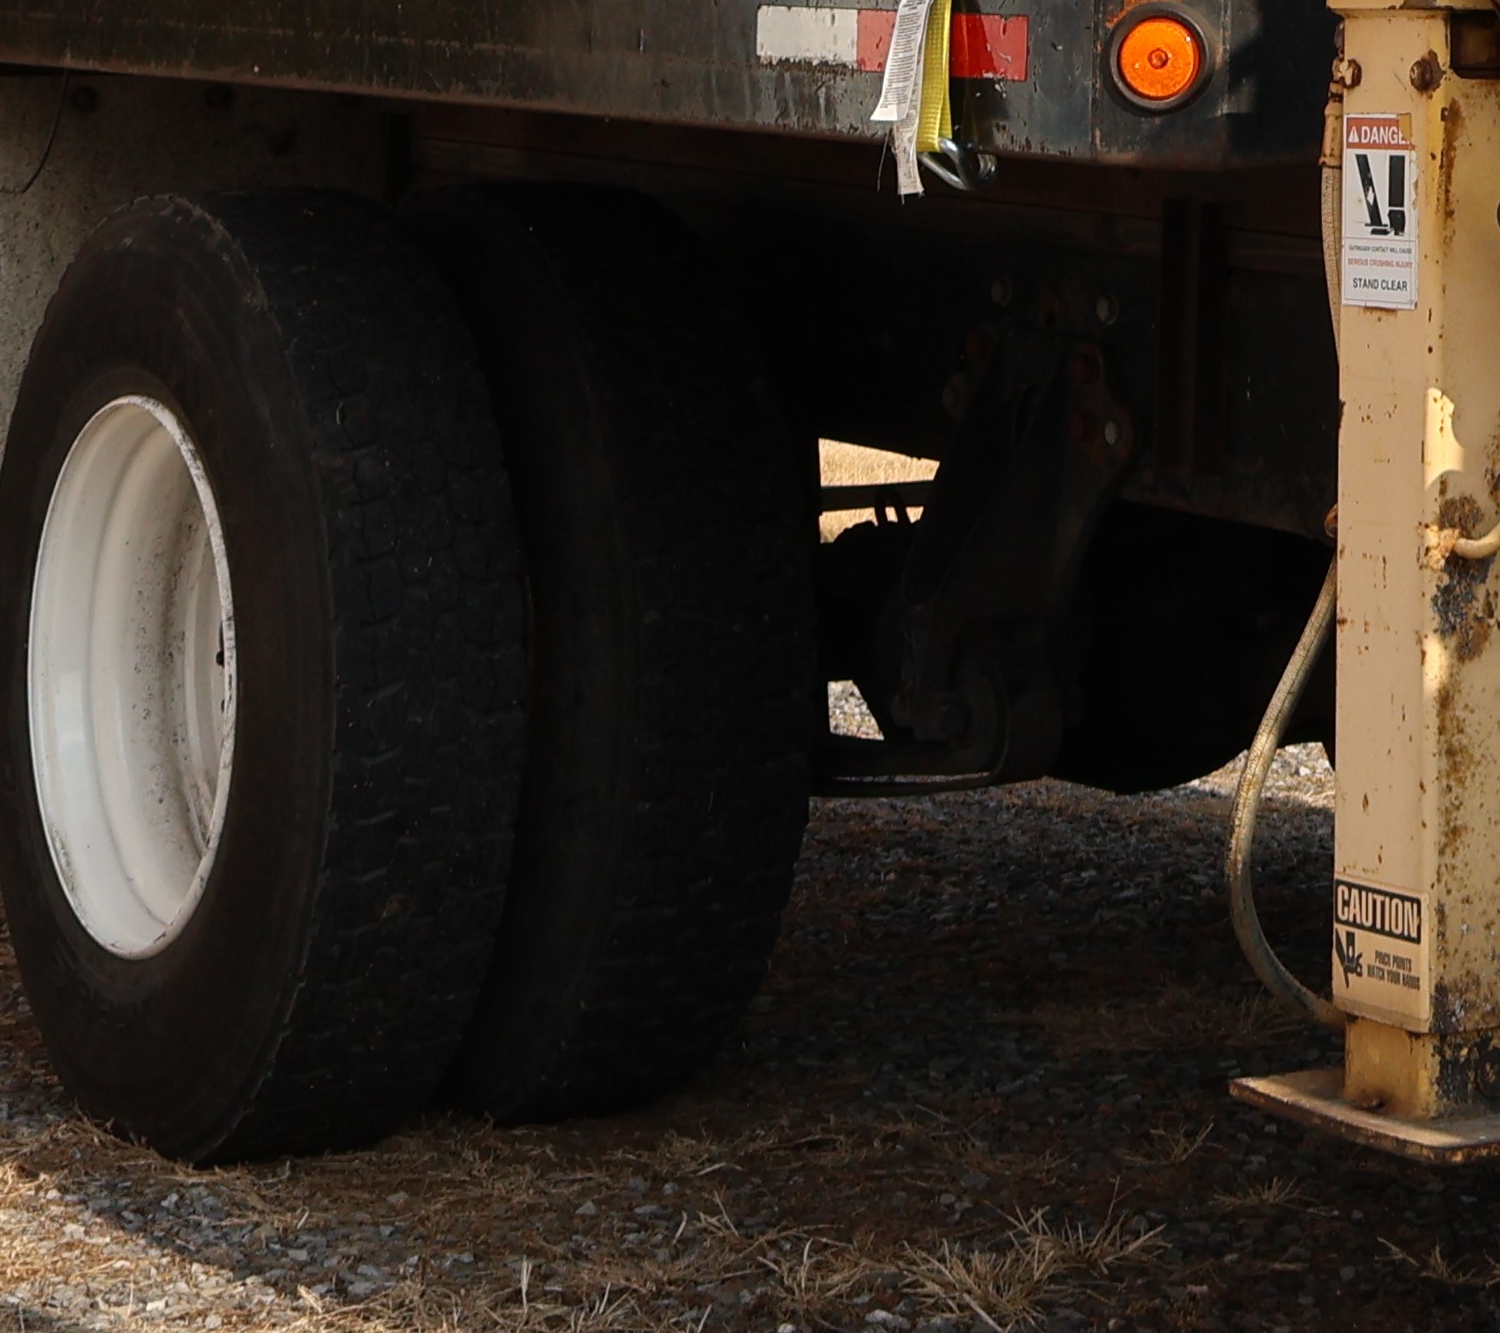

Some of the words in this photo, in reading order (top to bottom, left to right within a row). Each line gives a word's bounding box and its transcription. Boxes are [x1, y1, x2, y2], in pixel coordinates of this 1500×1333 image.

[1361, 125, 1410, 145] DANGE
[1352, 276, 1379, 290] STAND
[1380, 278, 1408, 292] CLEAR
[1337, 884, 1419, 939] CAUTION
